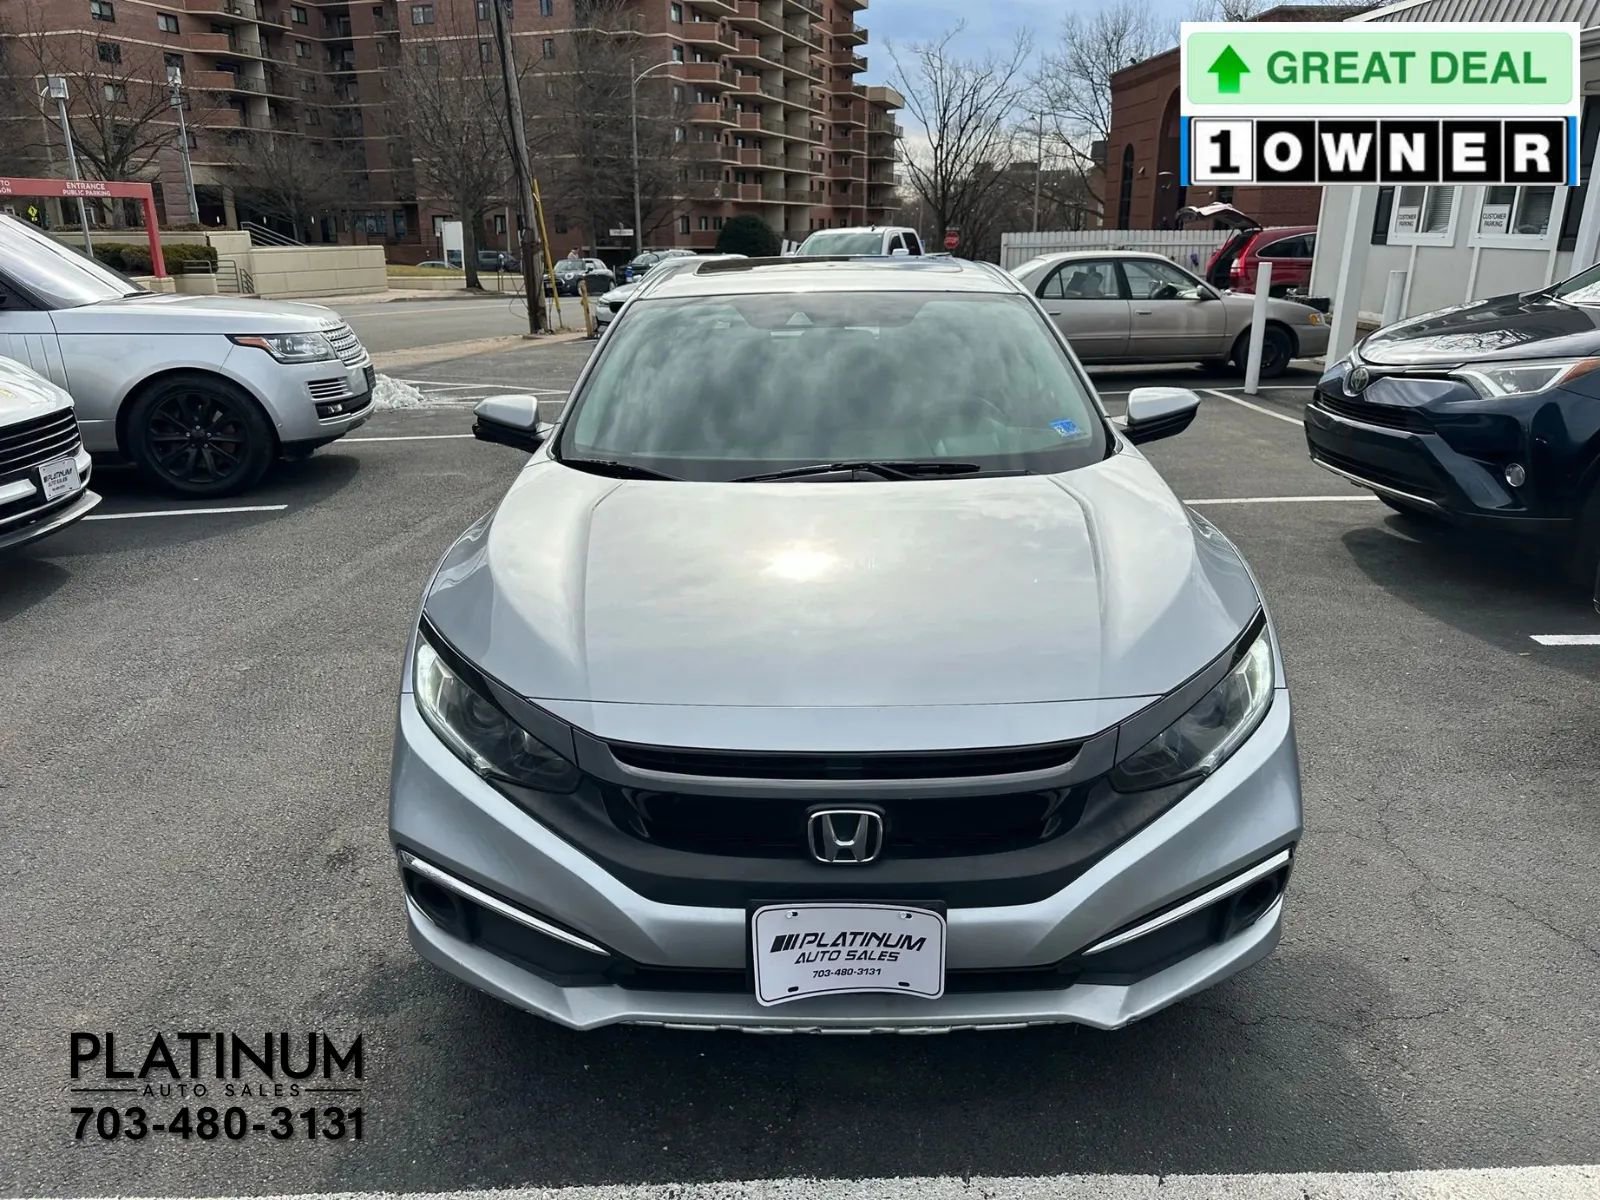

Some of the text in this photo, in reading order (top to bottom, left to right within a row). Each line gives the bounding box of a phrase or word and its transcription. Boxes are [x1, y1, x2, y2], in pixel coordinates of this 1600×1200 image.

[66, 182, 105, 190] ENTRANCE
[798, 932, 927, 951] PLATINUM
[794, 950, 900, 964] AUTO SALES
[812, 968, 882, 978] 703-480-3131
